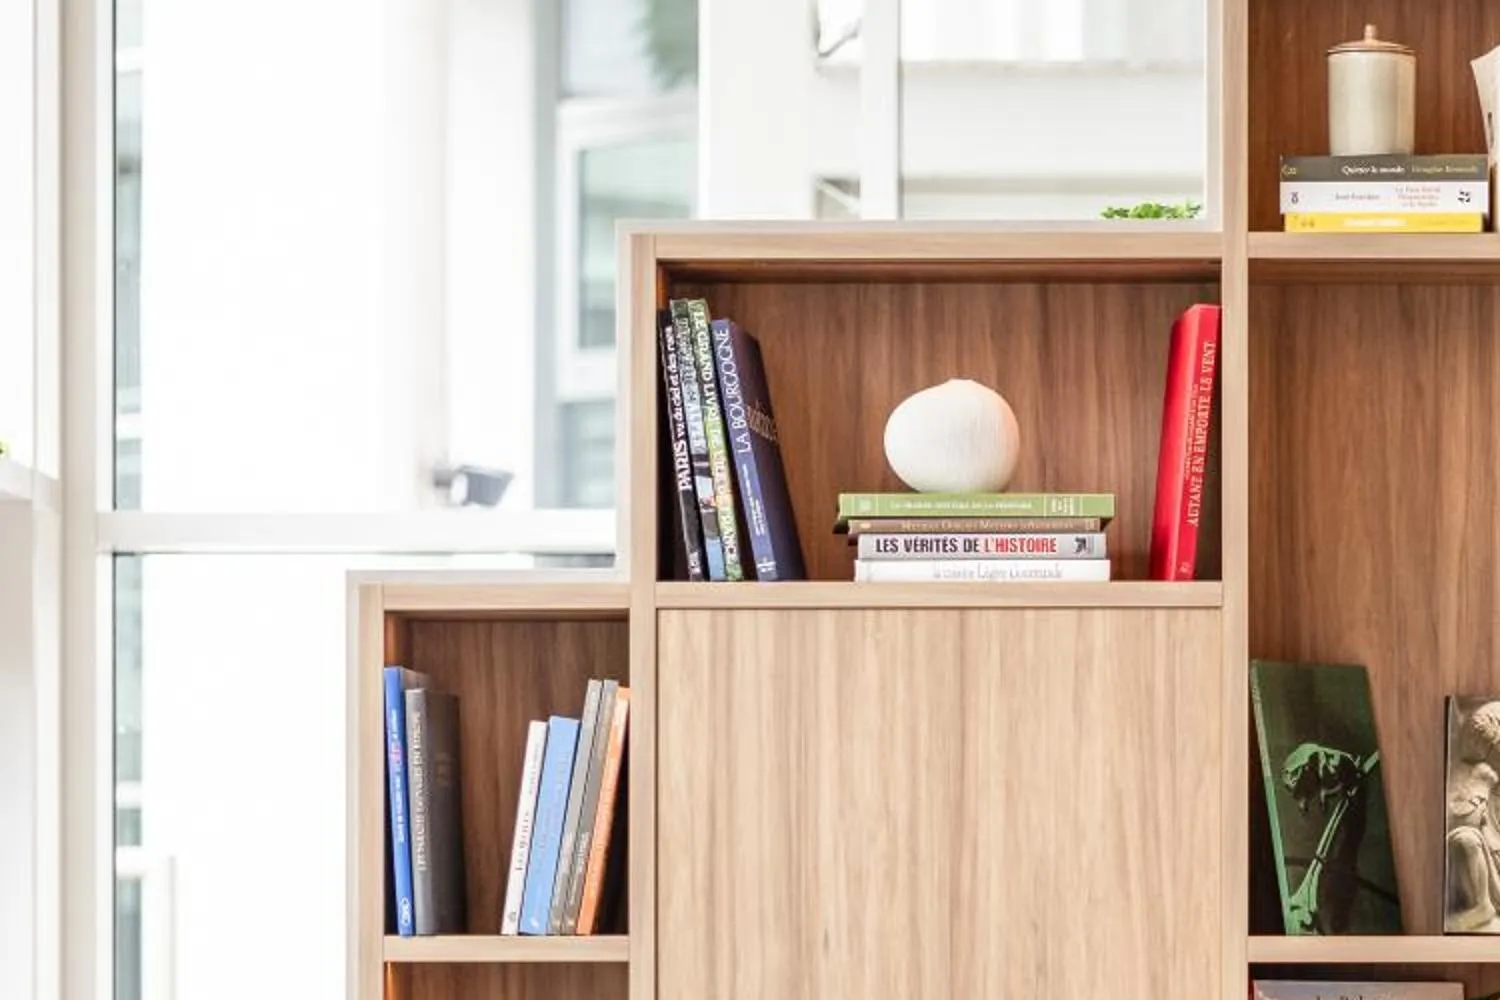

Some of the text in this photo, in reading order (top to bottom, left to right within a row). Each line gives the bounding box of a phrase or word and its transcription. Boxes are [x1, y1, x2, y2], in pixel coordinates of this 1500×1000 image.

[693, 310, 706, 330] LE
[698, 330, 713, 382] GRAND
[1200, 339, 1216, 374] VENT
[716, 327, 751, 454] LA BOURGOGNE
[1199, 375, 1212, 391] LE
[671, 405, 683, 421] du
[1193, 396, 1210, 452] EMPORTE
[675, 423, 685, 437] vu
[676, 438, 692, 491] PARIS
[1191, 454, 1204, 472] EN
[1185, 475, 1202, 527] AUTANT
[875, 535, 1057, 553] LES VÉRITÉS DE L'HISTOIRE
